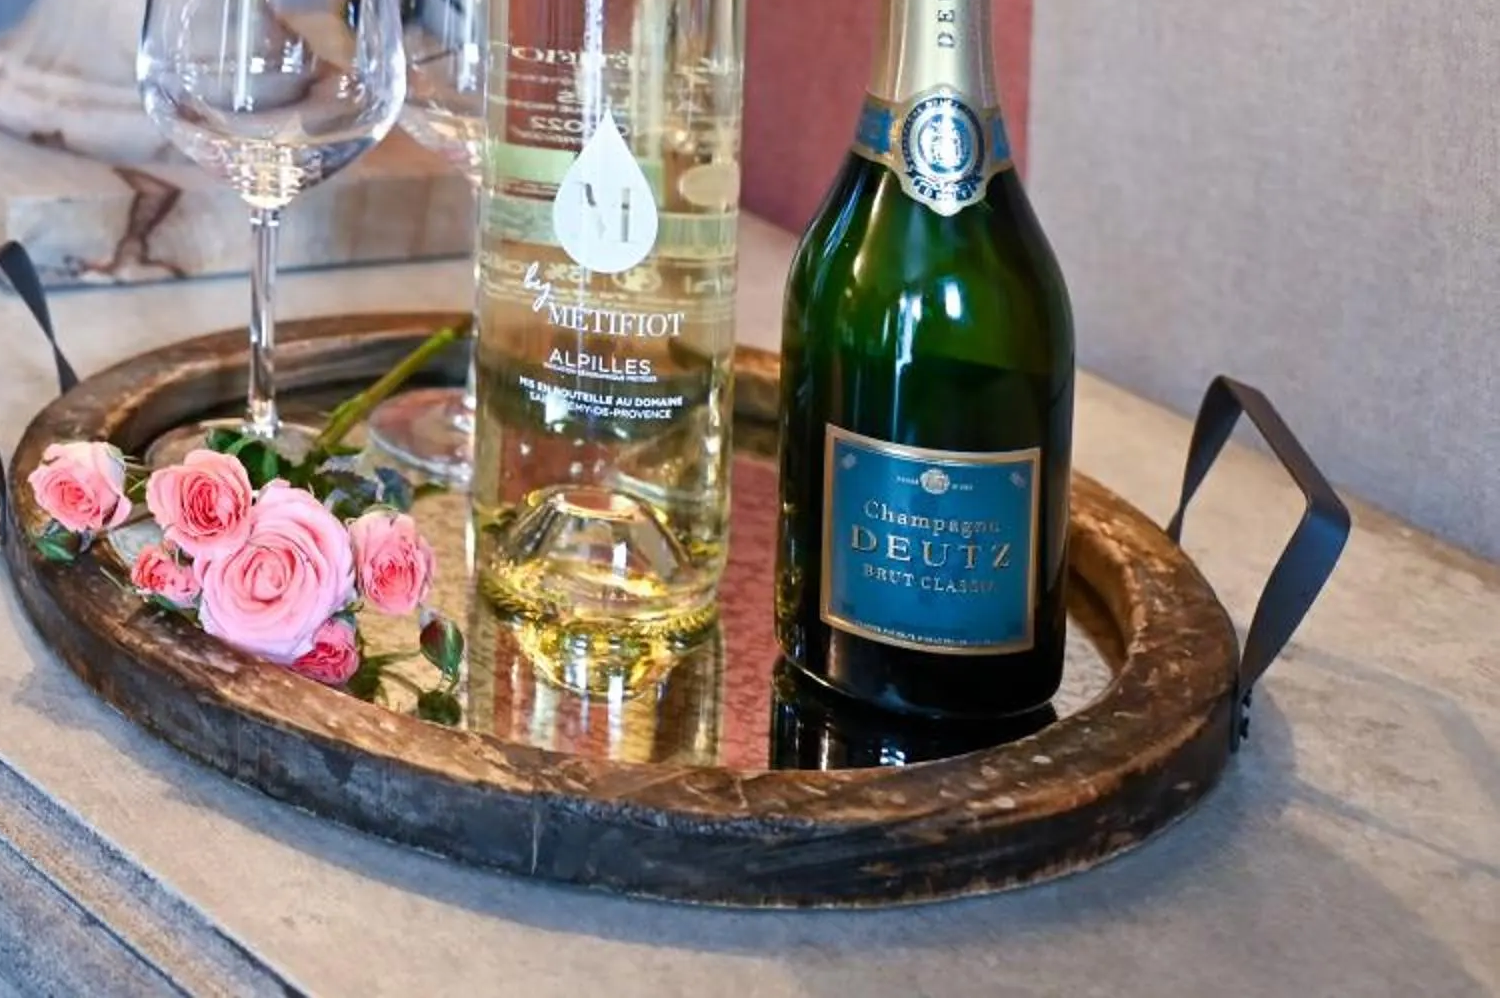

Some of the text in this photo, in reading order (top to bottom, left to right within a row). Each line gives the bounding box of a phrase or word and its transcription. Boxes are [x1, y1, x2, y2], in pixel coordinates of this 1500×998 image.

[549, 348, 652, 375] ALPILLES
[615, 396, 632, 407] AU
[851, 524, 1011, 570] DEUTZ
[865, 563, 915, 587] BRUT
